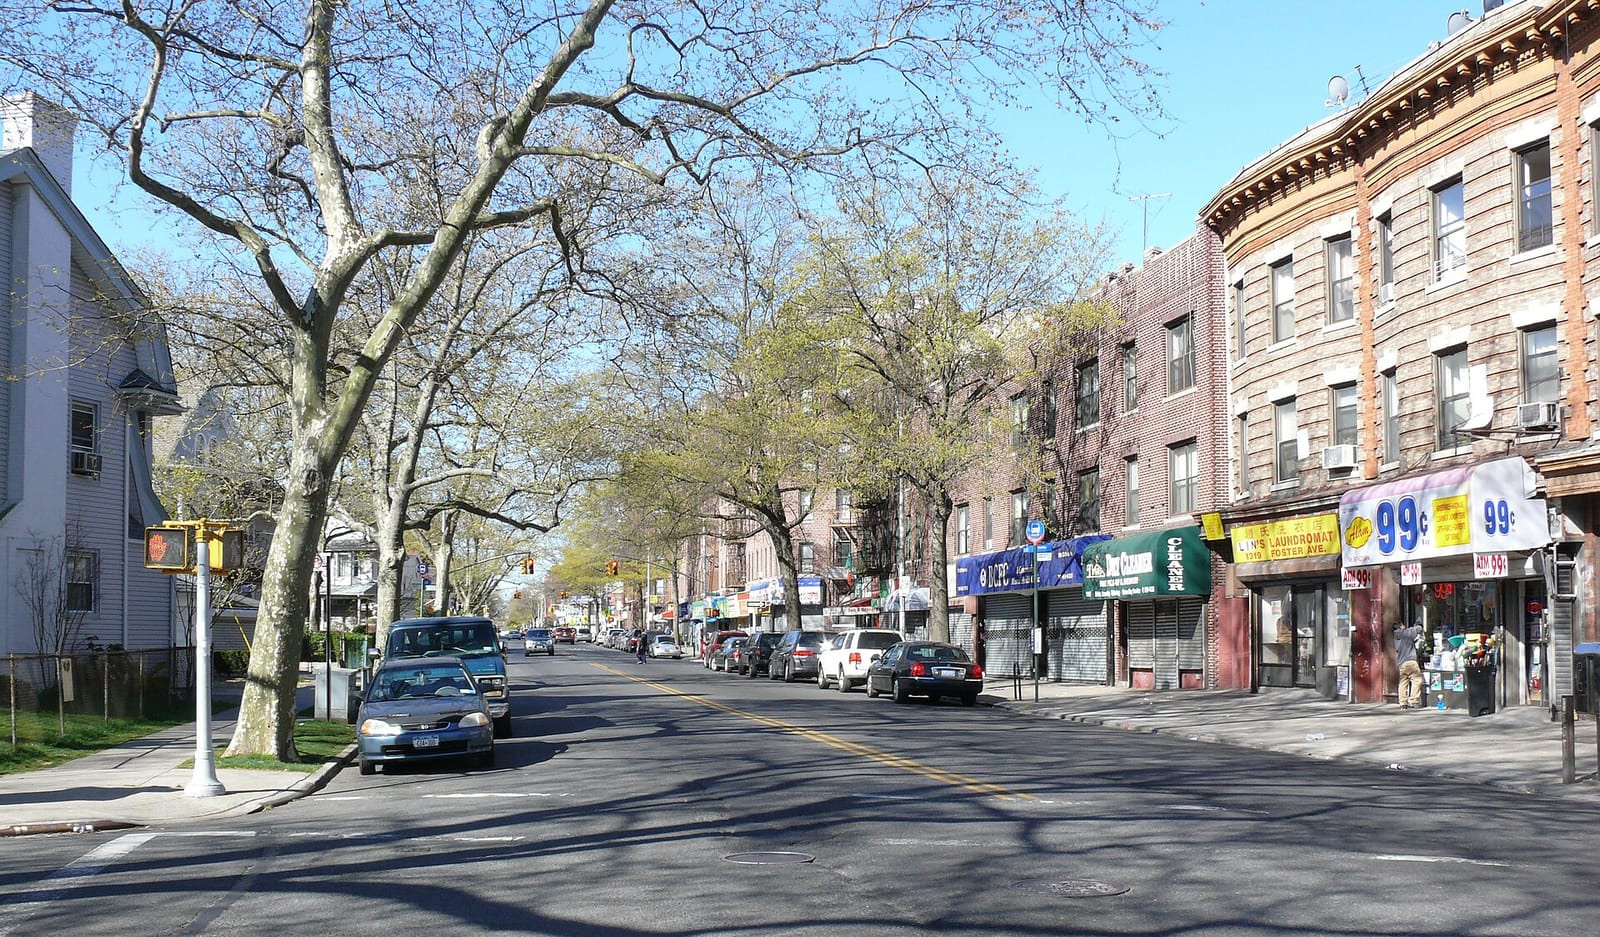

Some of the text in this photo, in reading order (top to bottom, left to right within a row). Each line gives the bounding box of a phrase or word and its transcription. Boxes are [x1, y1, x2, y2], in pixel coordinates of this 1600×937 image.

[1270, 531, 1334, 548] LAUNDROMAT
[1246, 544, 1327, 560] 1319 FOSTER AVE.
[1167, 537, 1184, 591] CLEANER
[1476, 555, 1490, 570] ATM
[1344, 569, 1356, 582] ATM
